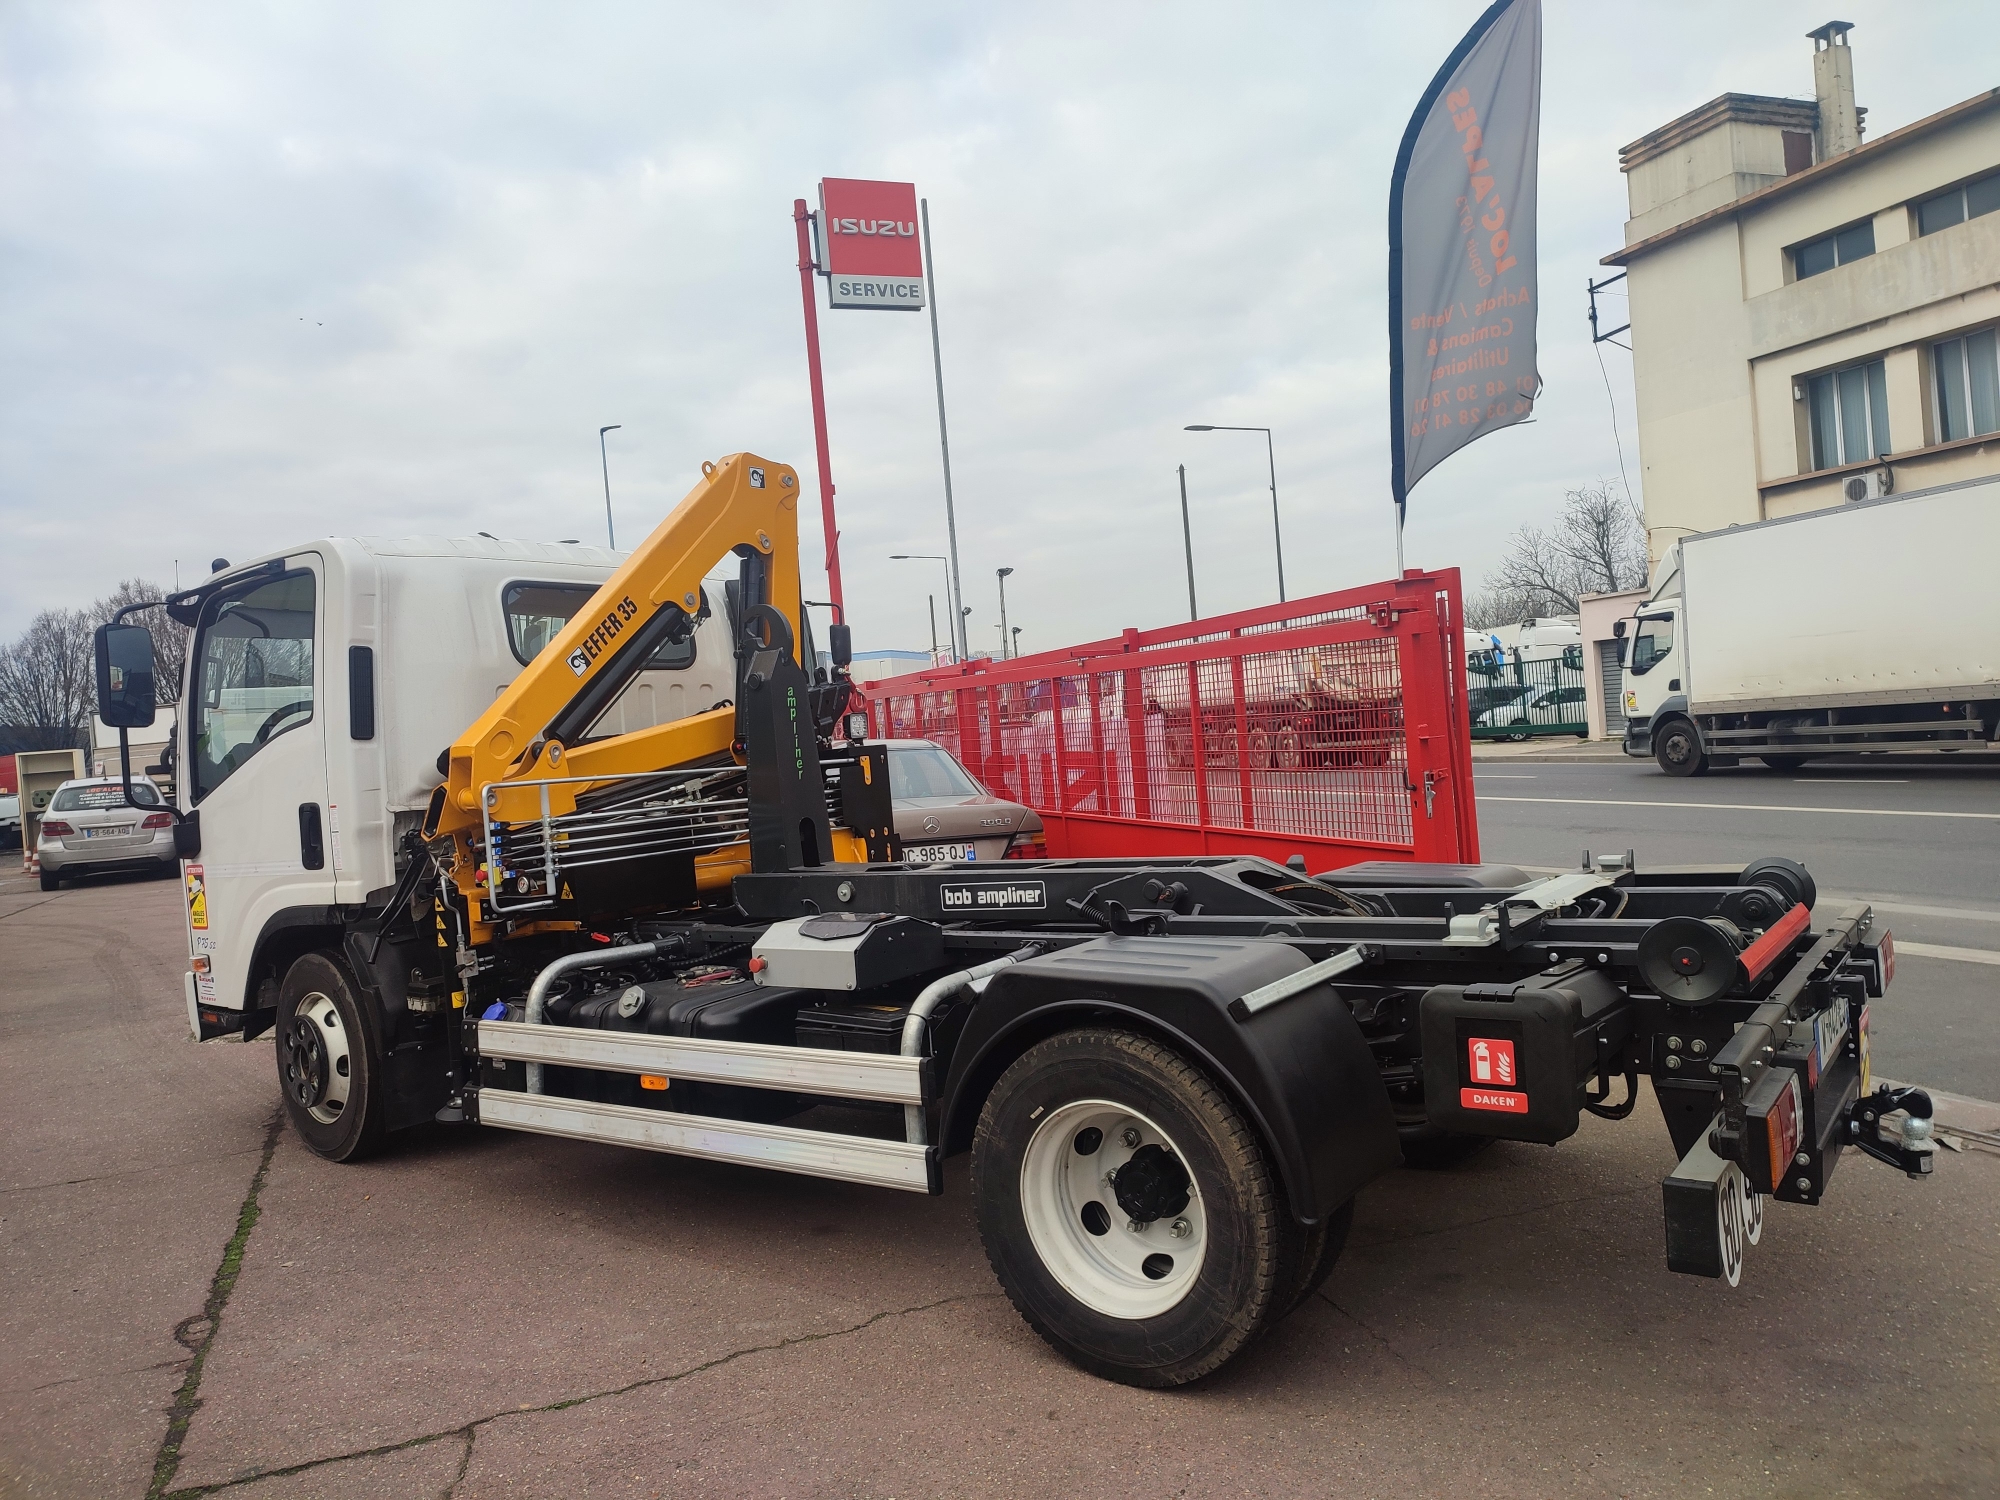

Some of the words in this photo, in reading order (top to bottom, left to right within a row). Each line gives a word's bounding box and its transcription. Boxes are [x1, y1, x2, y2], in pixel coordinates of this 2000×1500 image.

[832, 217, 915, 238] ISUZU
[839, 281, 920, 299] SERVICE
[581, 611, 625, 661] EFFER
[616, 595, 638, 622] 35
[786, 686, 804, 780] ampliner
[944, 888, 972, 905] bob
[977, 886, 1042, 907] ampliner
[1473, 1094, 1515, 1107] DAKEN
[1720, 1175, 1741, 1278] 80
